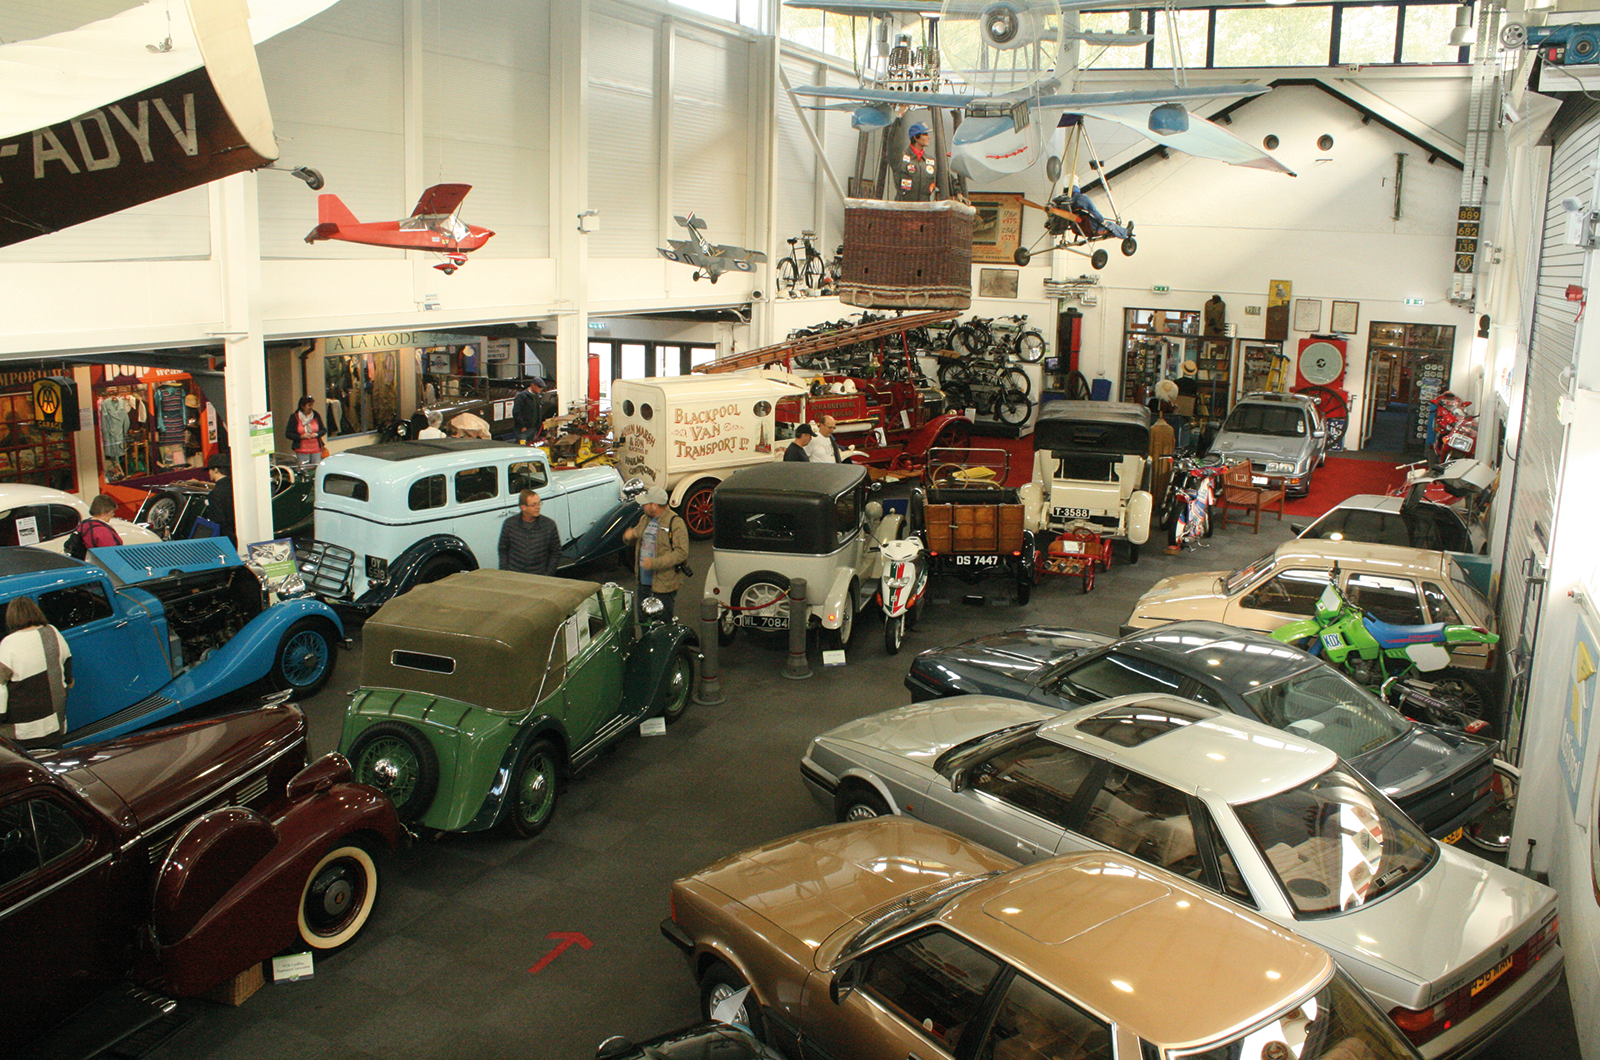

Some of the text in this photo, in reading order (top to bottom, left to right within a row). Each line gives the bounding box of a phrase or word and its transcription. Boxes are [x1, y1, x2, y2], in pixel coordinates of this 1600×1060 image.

[0, 92, 199, 184] -ADYV
[1459, 211, 1480, 220] 889
[1458, 227, 1478, 236] 682
[1458, 243, 1475, 252] 138
[334, 337, 345, 350] A
[350, 334, 368, 349] LA
[373, 333, 418, 347] MODE
[810, 401, 857, 411] JOHANNESBURG
[674, 403, 742, 425] BLACKPOOL
[831, 409, 855, 418] BRIGADE
[37, 420, 63, 430] GARAGE
[635, 424, 656, 448] MARSH
[690, 424, 721, 442] VAN
[674, 436, 738, 460] TRANSPORT
[370, 557, 381, 569] OY
[956, 555, 998, 565] DS 7447
[744, 615, 788, 628] WL 7084
[1322, 633, 1343, 648] KDX
